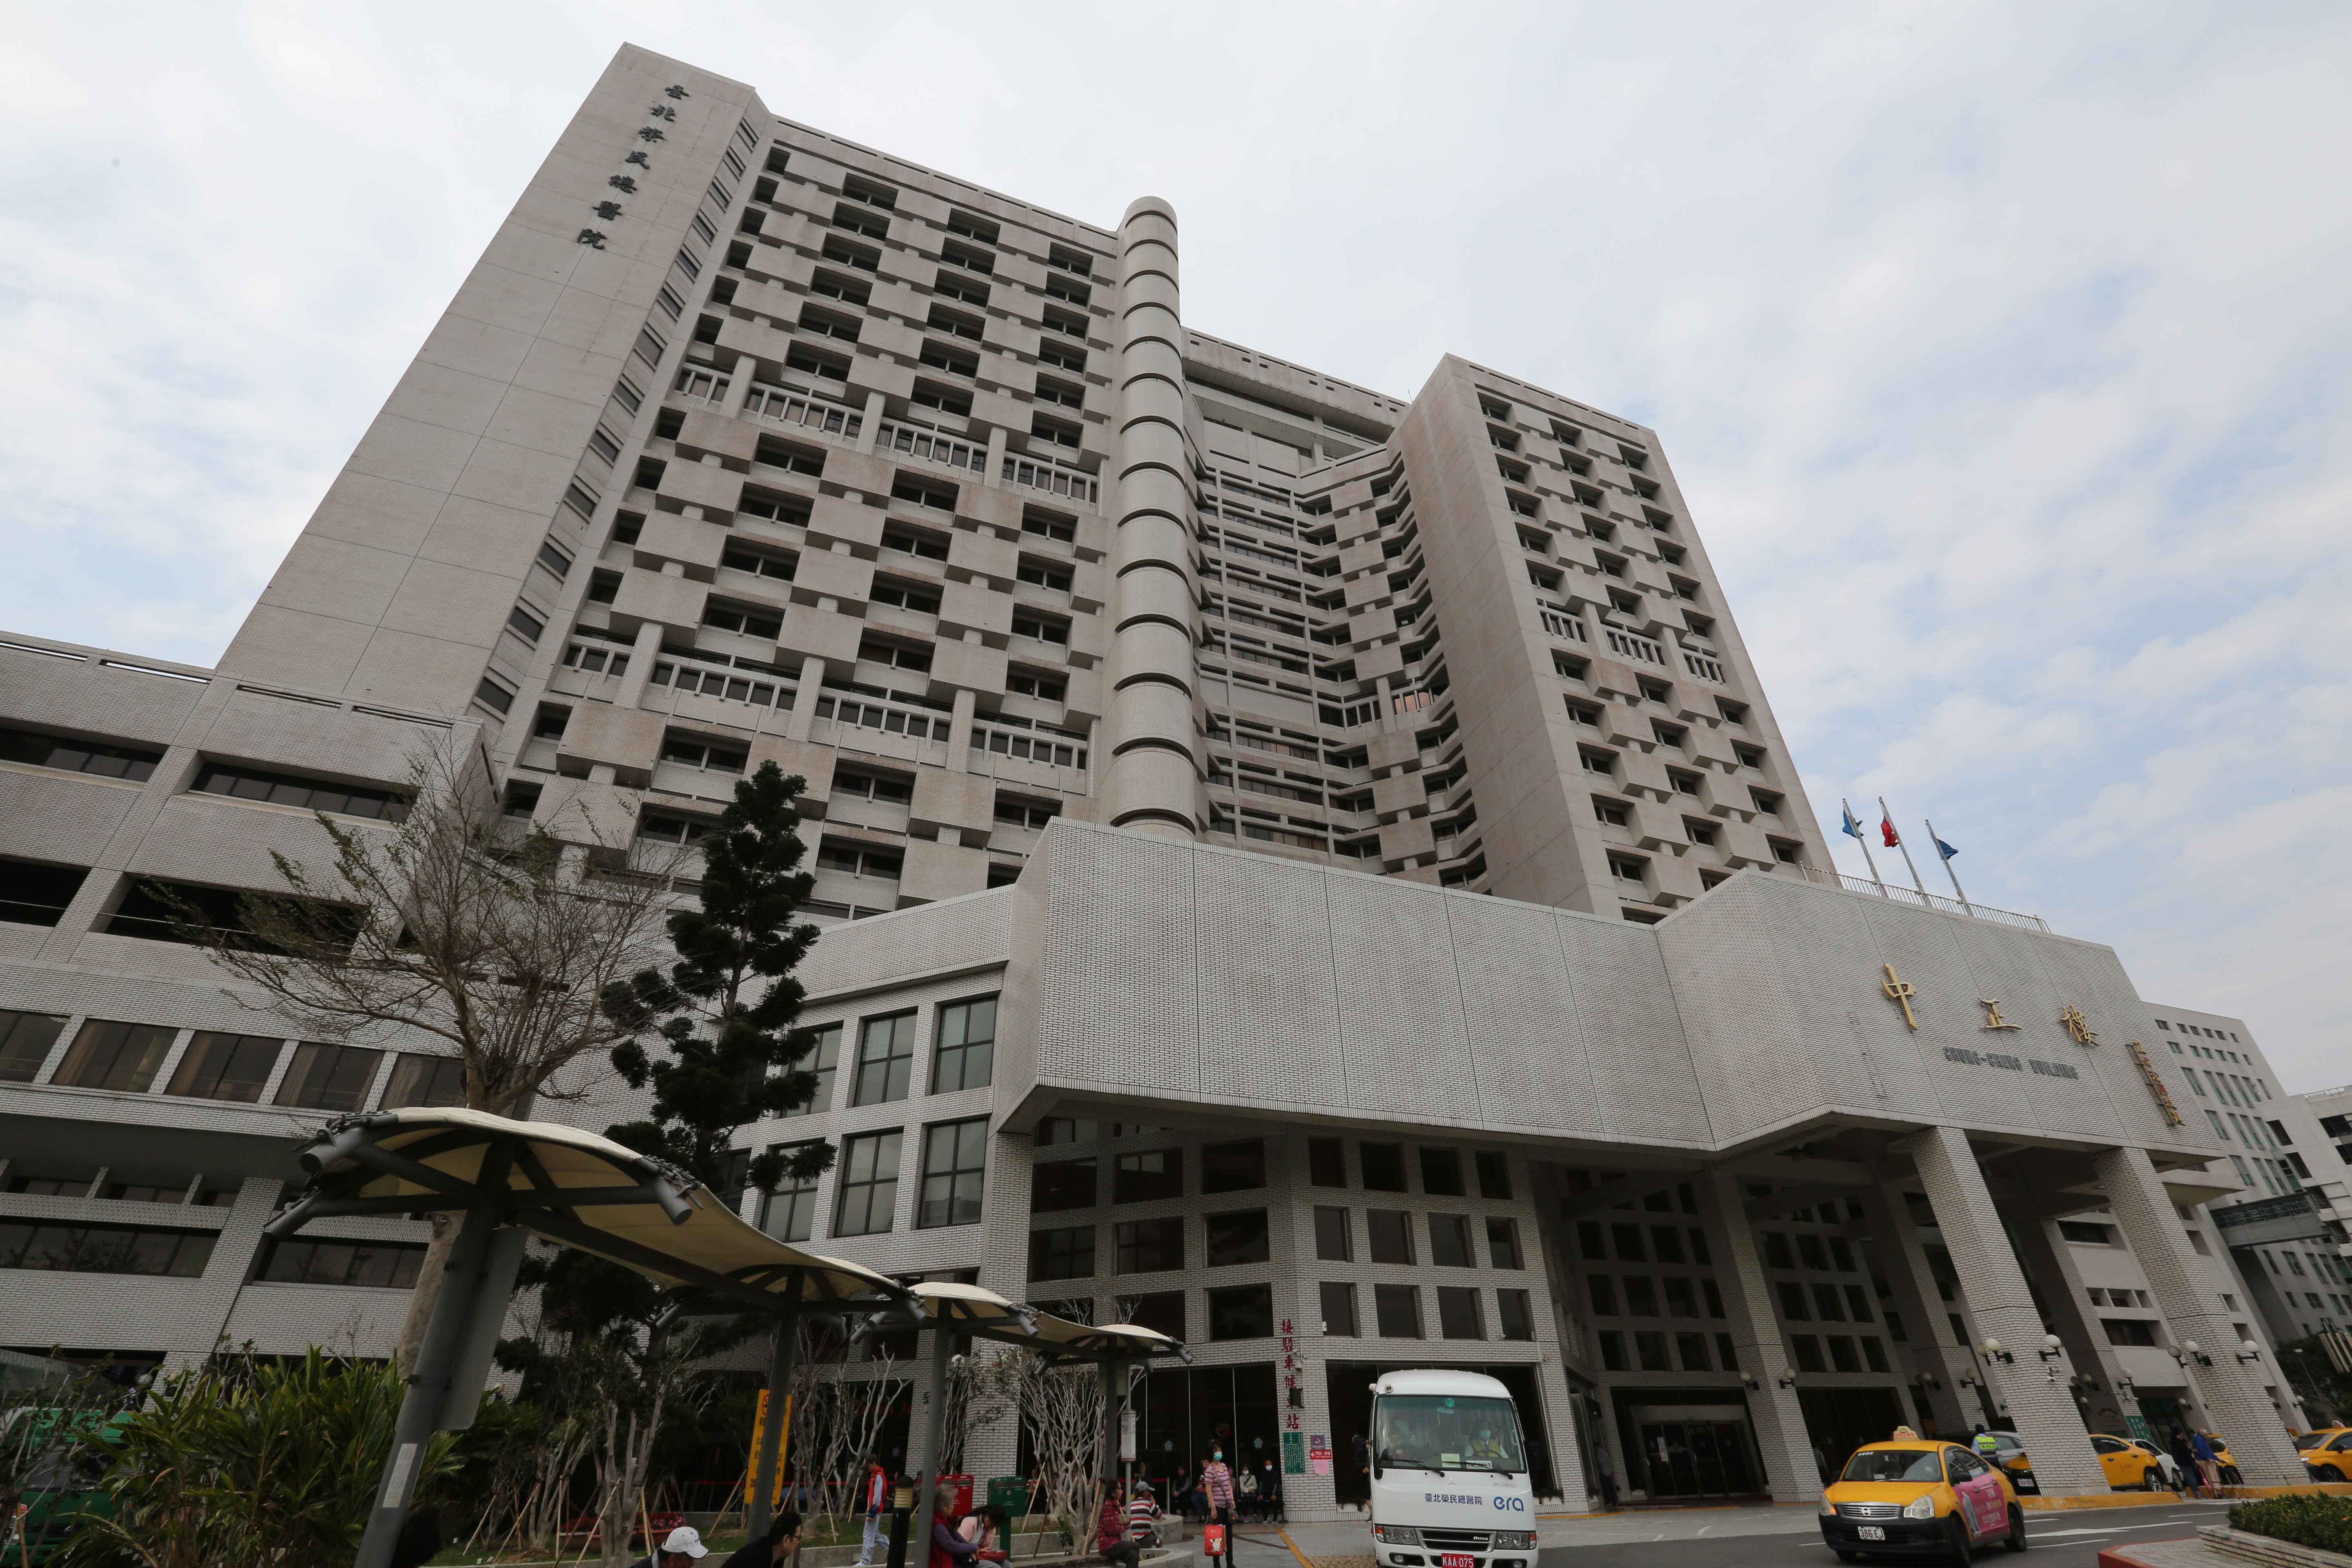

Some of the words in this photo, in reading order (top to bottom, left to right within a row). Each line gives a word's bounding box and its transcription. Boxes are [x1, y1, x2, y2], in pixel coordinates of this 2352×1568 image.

[577, 84, 690, 249] 臺北榮民總醫院
[1880, 963, 2100, 1047] 中正樓
[1942, 1046, 2023, 1071] CHUNG-CHENG
[2029, 1058, 2079, 1080] BUILDING
[1425, 1492, 1483, 1506] 臺北榮民總醫院
[1493, 1496, 1524, 1512] era
